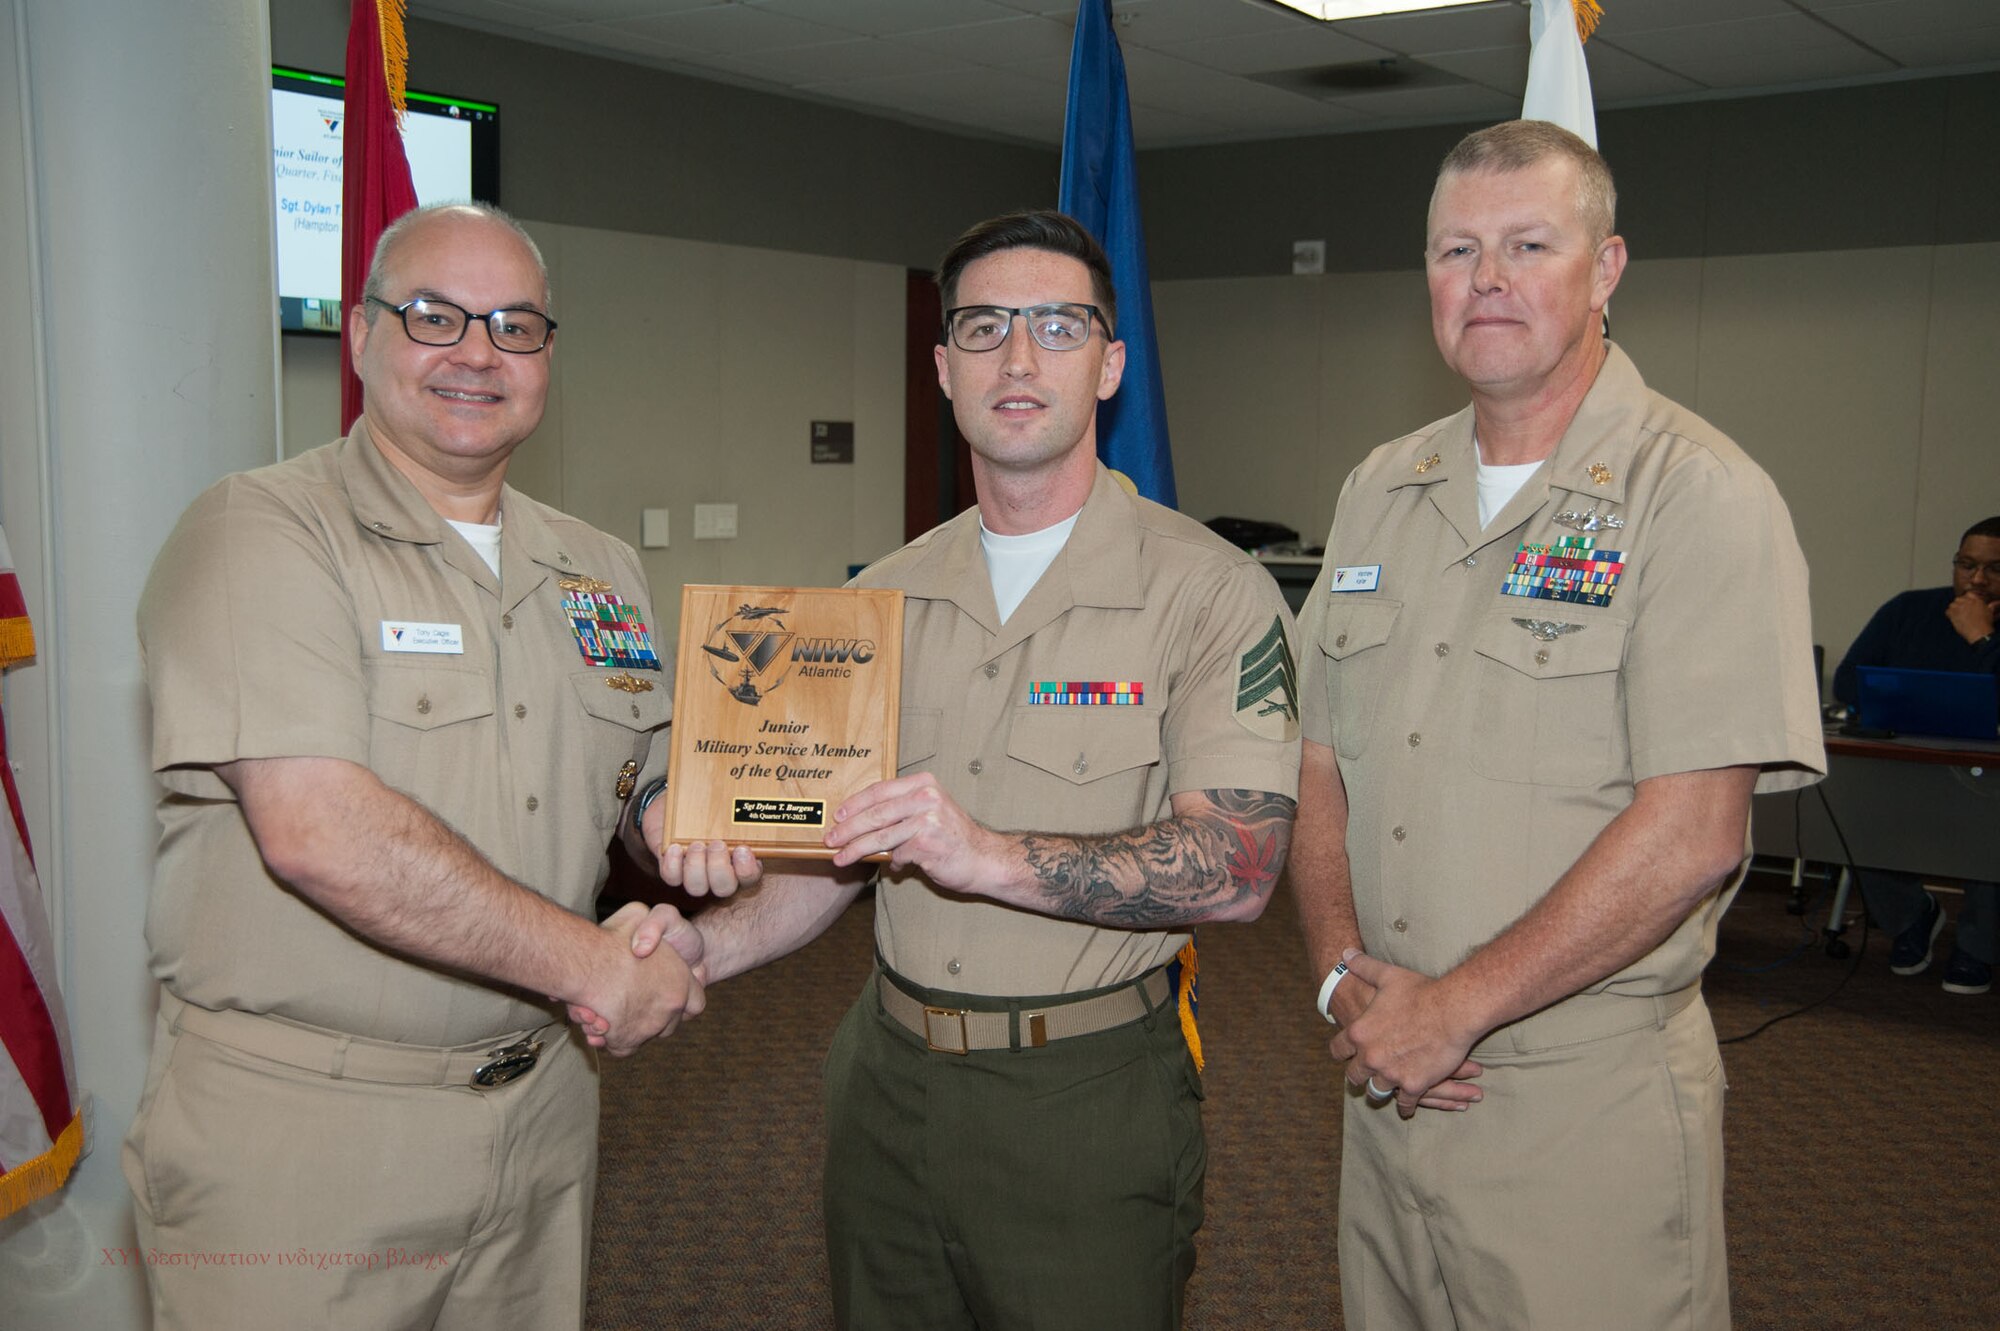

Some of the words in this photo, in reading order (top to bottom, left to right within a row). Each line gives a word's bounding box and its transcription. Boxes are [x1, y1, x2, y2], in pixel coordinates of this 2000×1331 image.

[299, 149, 329, 162] Sailor
[332, 156, 343, 167] of
[304, 200, 331, 216] Dylan
[294, 217, 339, 233] (Hampton
[791, 637, 876, 664] NIWC
[798, 665, 852, 679] Atlantic
[758, 719, 810, 735] Junior
[694, 739, 752, 758] Military
[755, 741, 808, 757] Service
[811, 743, 872, 758] Member
[730, 763, 748, 779] of
[749, 764, 772, 778] the
[775, 764, 832, 781] Quarter
[743, 802, 756, 812] Sgt
[756, 802, 777, 812] Dylan
[779, 803, 785, 811] T.
[786, 803, 815, 813] Burgess
[782, 813, 807, 821] FY-2023
